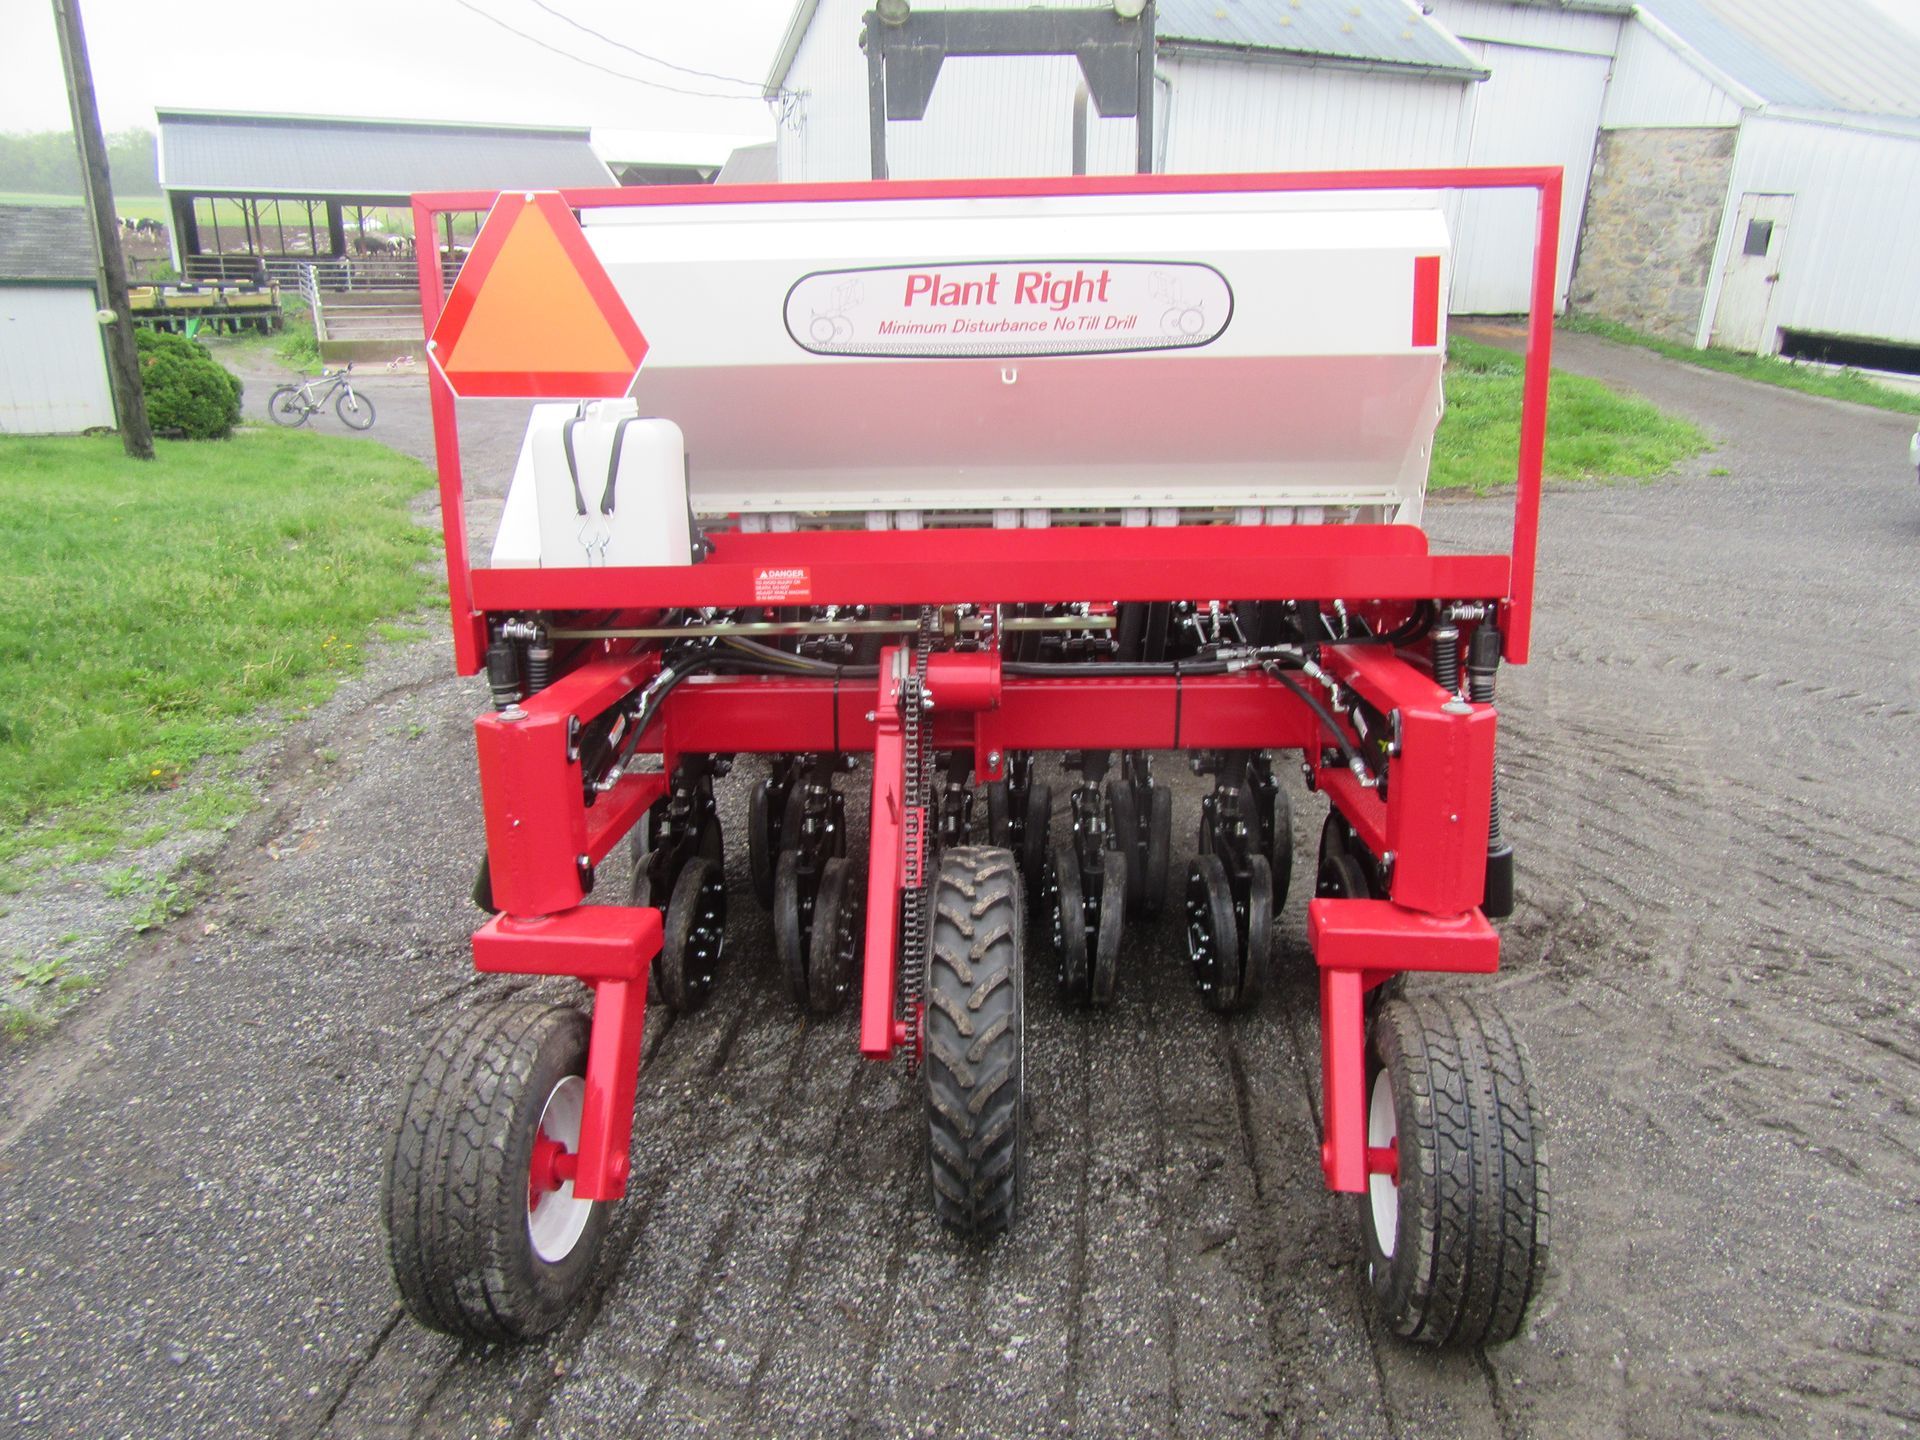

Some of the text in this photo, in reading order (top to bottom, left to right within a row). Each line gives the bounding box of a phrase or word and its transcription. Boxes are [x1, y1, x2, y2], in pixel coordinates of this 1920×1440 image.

[903, 269, 1112, 311] Plant Right
[878, 319, 947, 335] Minimum
[952, 317, 1048, 334] Disturbance
[1103, 314, 1138, 330] Drill
[768, 569, 804, 577] DANGER
